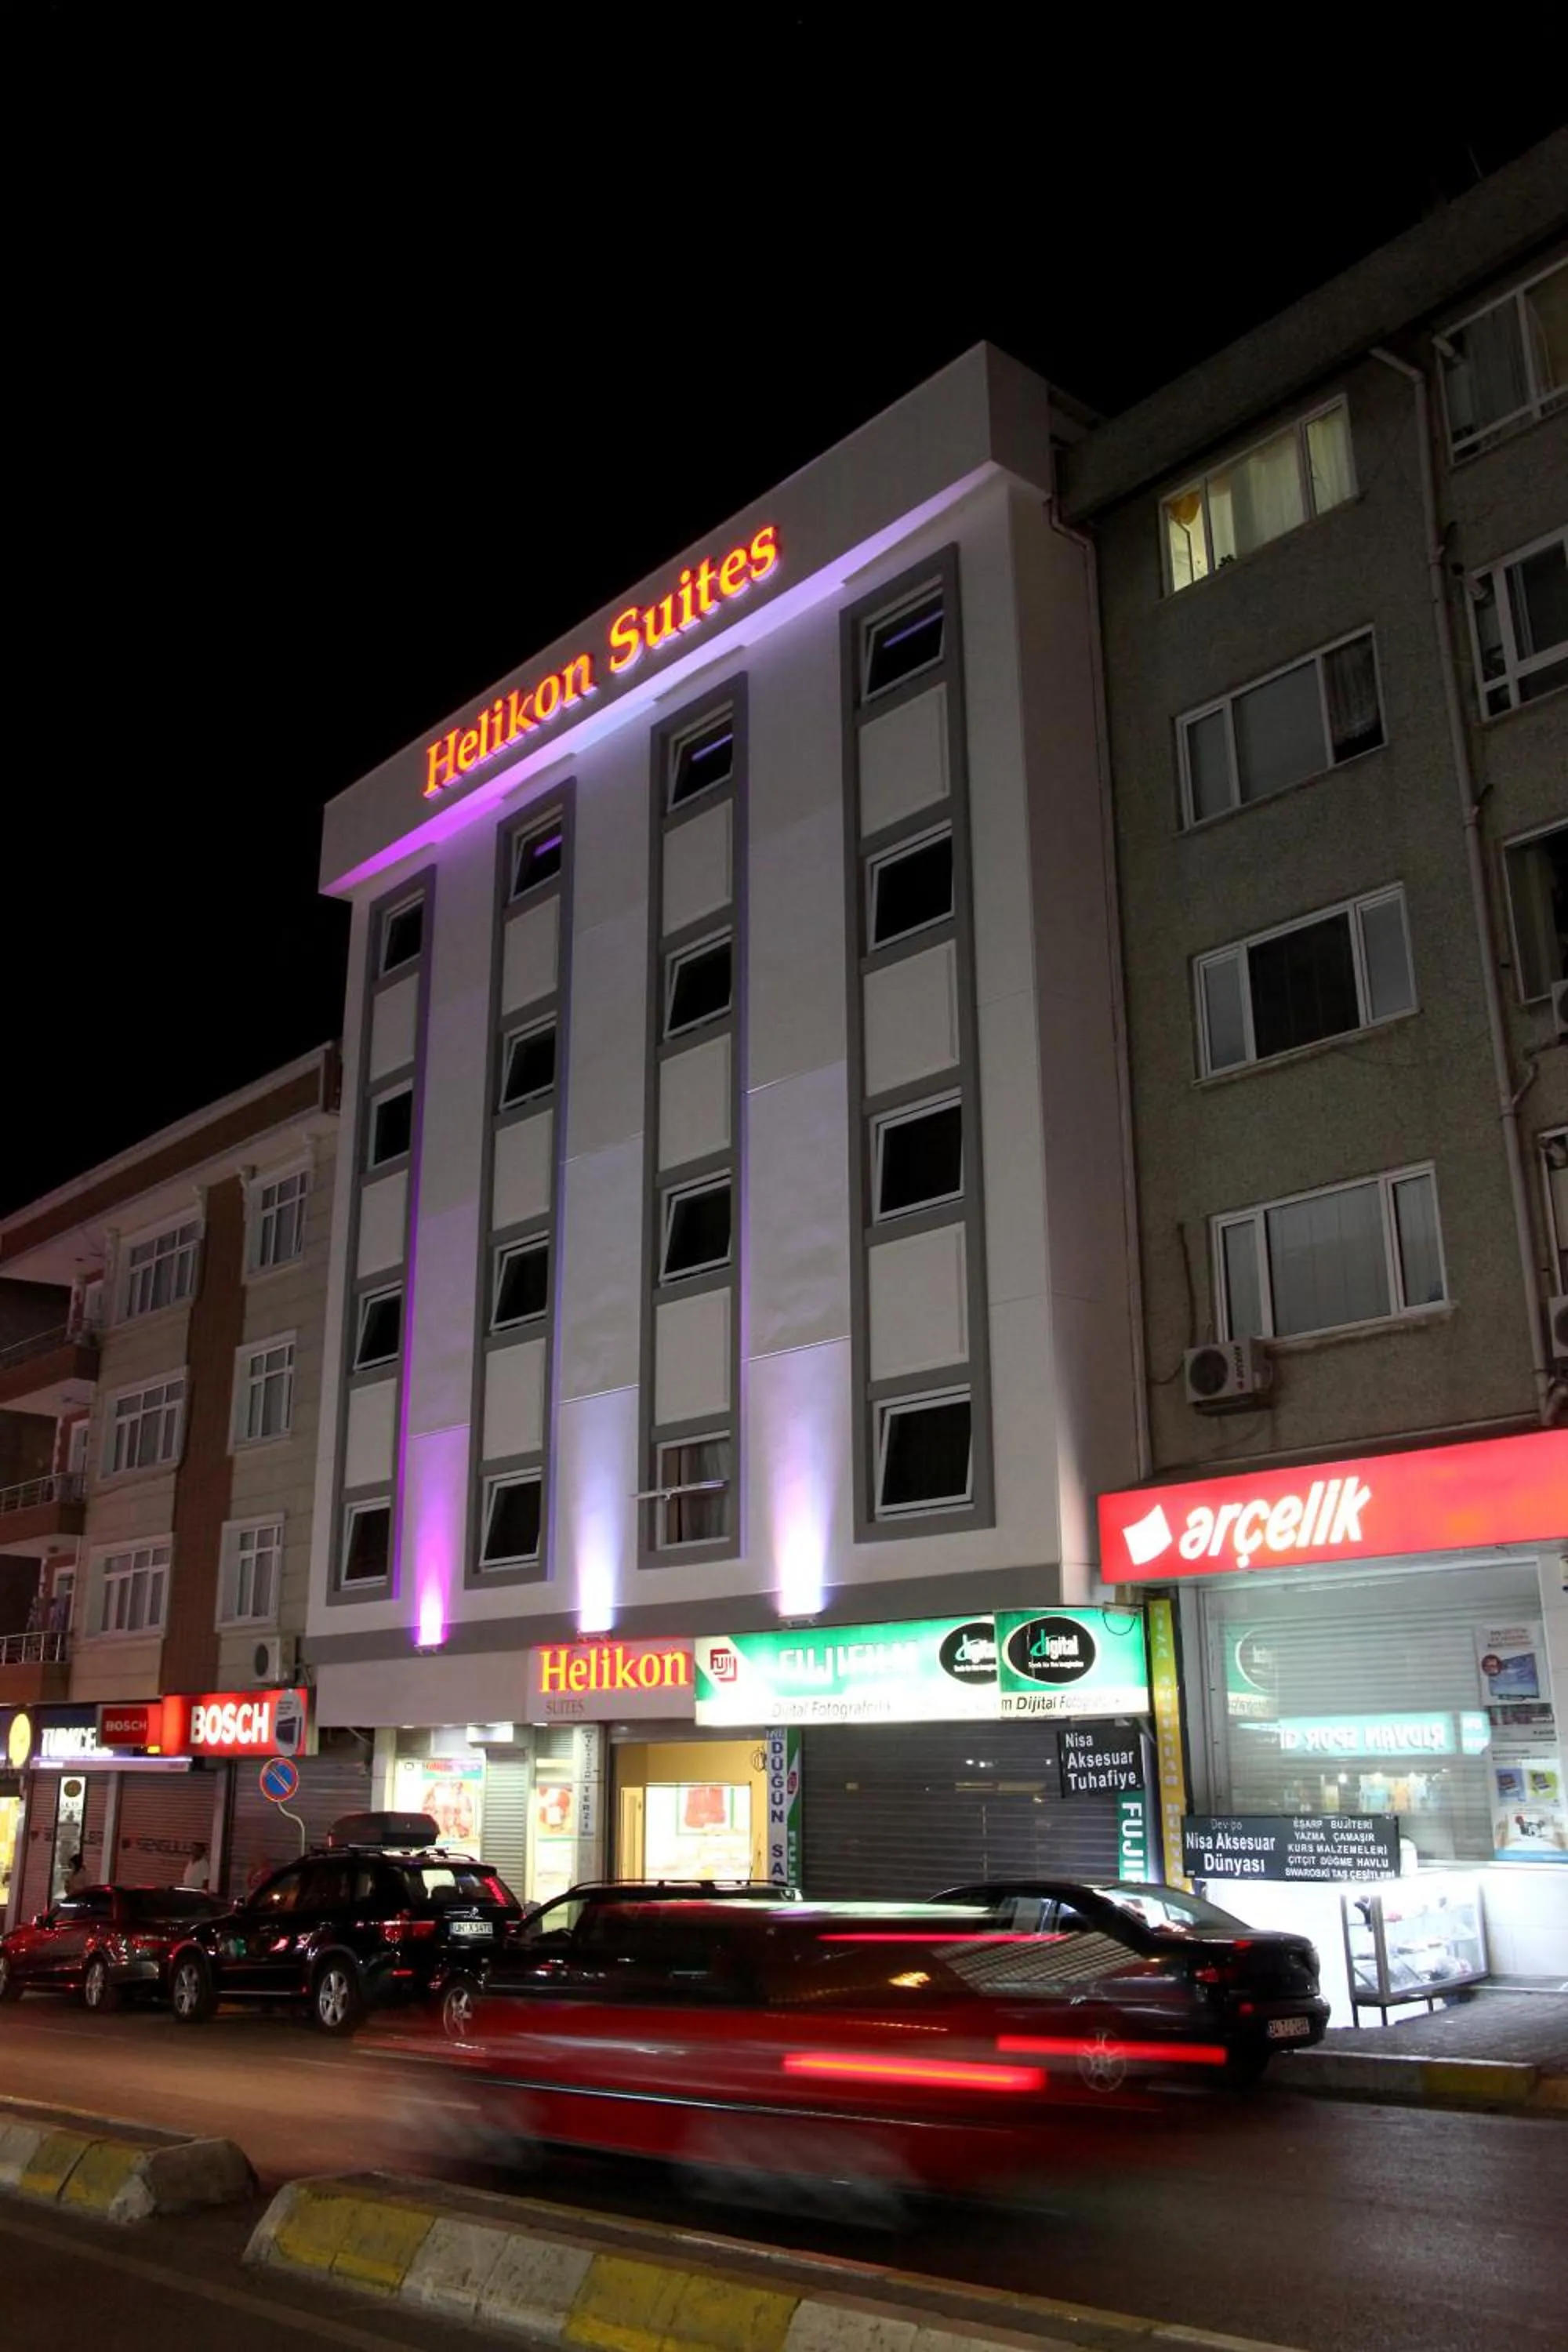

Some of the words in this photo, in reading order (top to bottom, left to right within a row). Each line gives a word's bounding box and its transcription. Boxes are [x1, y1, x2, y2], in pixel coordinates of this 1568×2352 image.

[423, 652, 593, 795] Helikon
[608, 526, 779, 671] Suites
[1179, 1475, 1372, 1568] arçelik
[1030, 1628, 1079, 1660] digital
[539, 1645, 688, 1693] Helikon
[710, 1648, 738, 1682] FUJI
[1016, 1696, 1056, 1713] Dijital
[106, 1719, 147, 1731] BOSCH
[190, 1702, 270, 1745] BOSCH
[1065, 1733, 1094, 1748] Nisa
[1067, 1751, 1134, 1769] Aksesuar
[1068, 1769, 1137, 1791] Tuhafiye
[1186, 1833, 1213, 1849] Nisa
[1216, 1833, 1276, 1851] Aksesuar
[1294, 1831, 1326, 1841] YAZMA
[1333, 1832, 1375, 1843] ÇAMAŞIR
[1287, 1844, 1314, 1853] KURS
[1316, 1844, 1388, 1855] MALZEMELERİ
[1204, 1853, 1265, 1876] Dünyası
[1356, 1857, 1389, 1868] HAVLU
